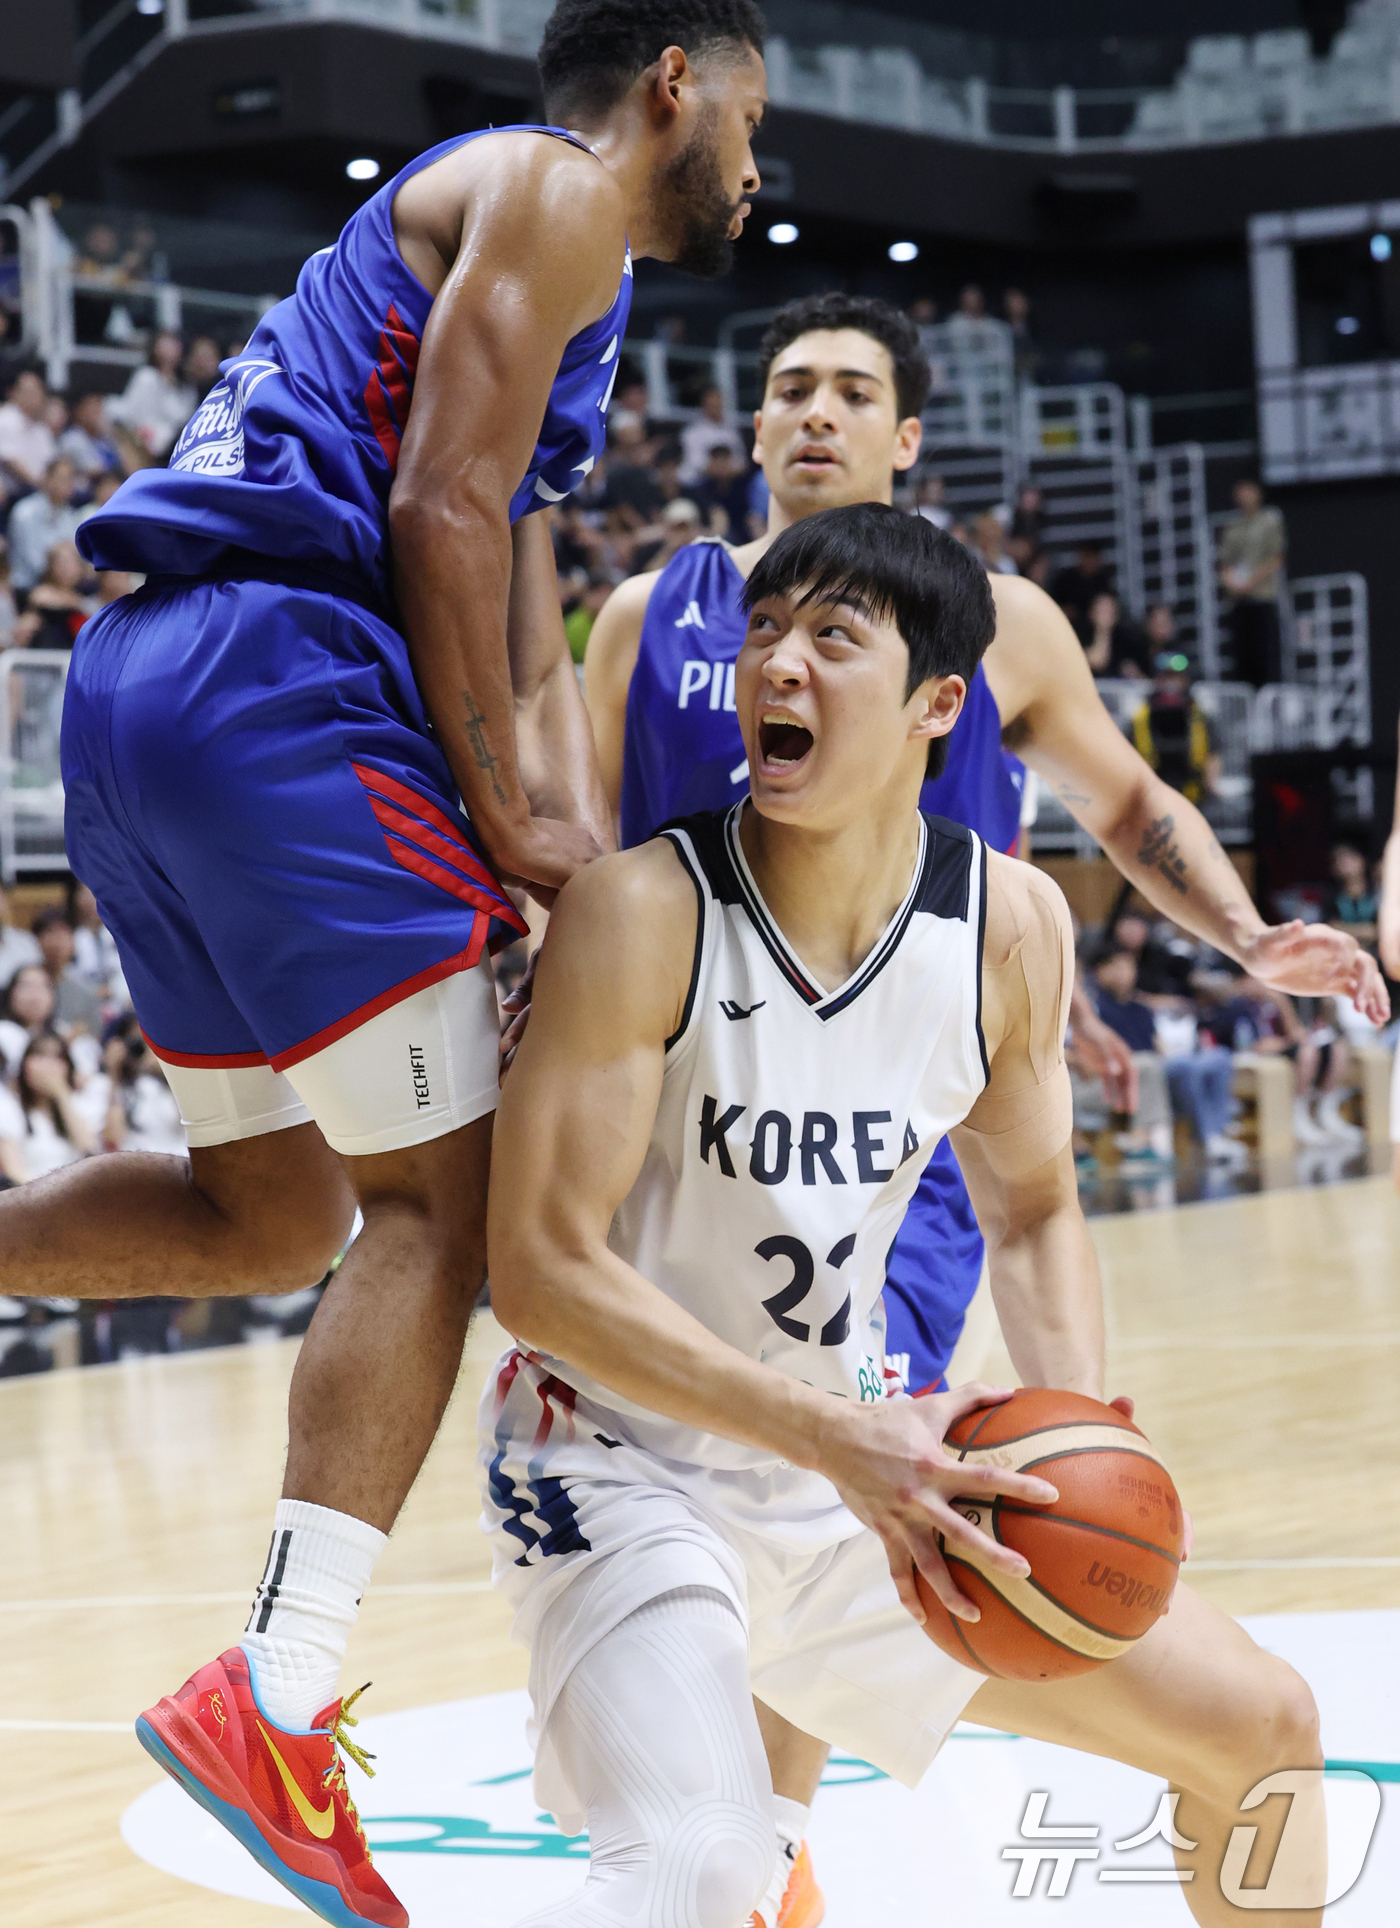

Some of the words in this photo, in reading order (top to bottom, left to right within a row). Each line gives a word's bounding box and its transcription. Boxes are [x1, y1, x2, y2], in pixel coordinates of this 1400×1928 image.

[678, 660, 737, 712] PIL
[408, 1044, 431, 1110] TECHFIT
[698, 1093, 920, 1186] KOREA
[753, 1232, 858, 1347] 22
[1086, 1561, 1170, 1612] molten
